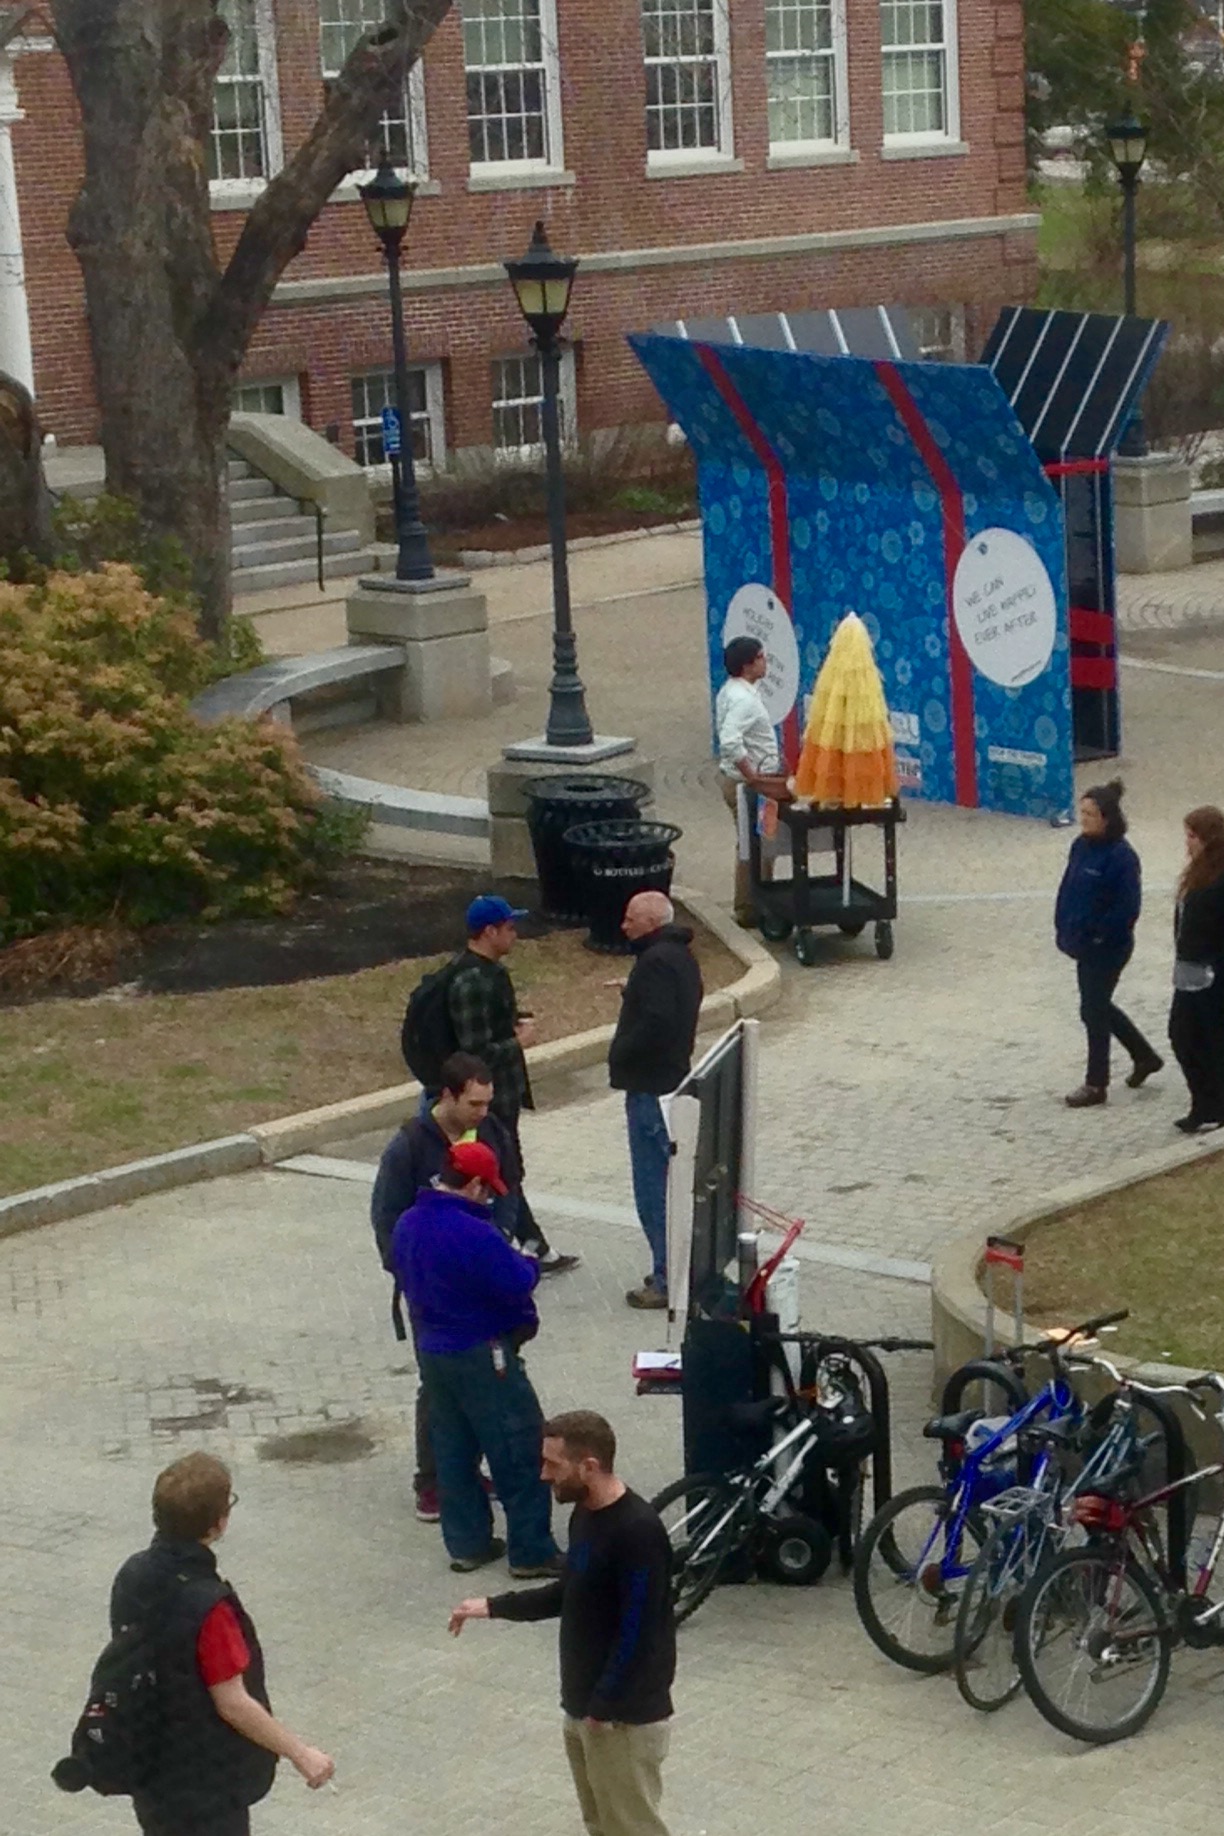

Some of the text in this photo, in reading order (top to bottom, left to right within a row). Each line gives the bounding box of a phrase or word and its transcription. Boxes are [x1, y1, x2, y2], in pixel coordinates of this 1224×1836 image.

[965, 576, 1004, 606] WE CAN
[1004, 611, 1037, 634] AFTER
